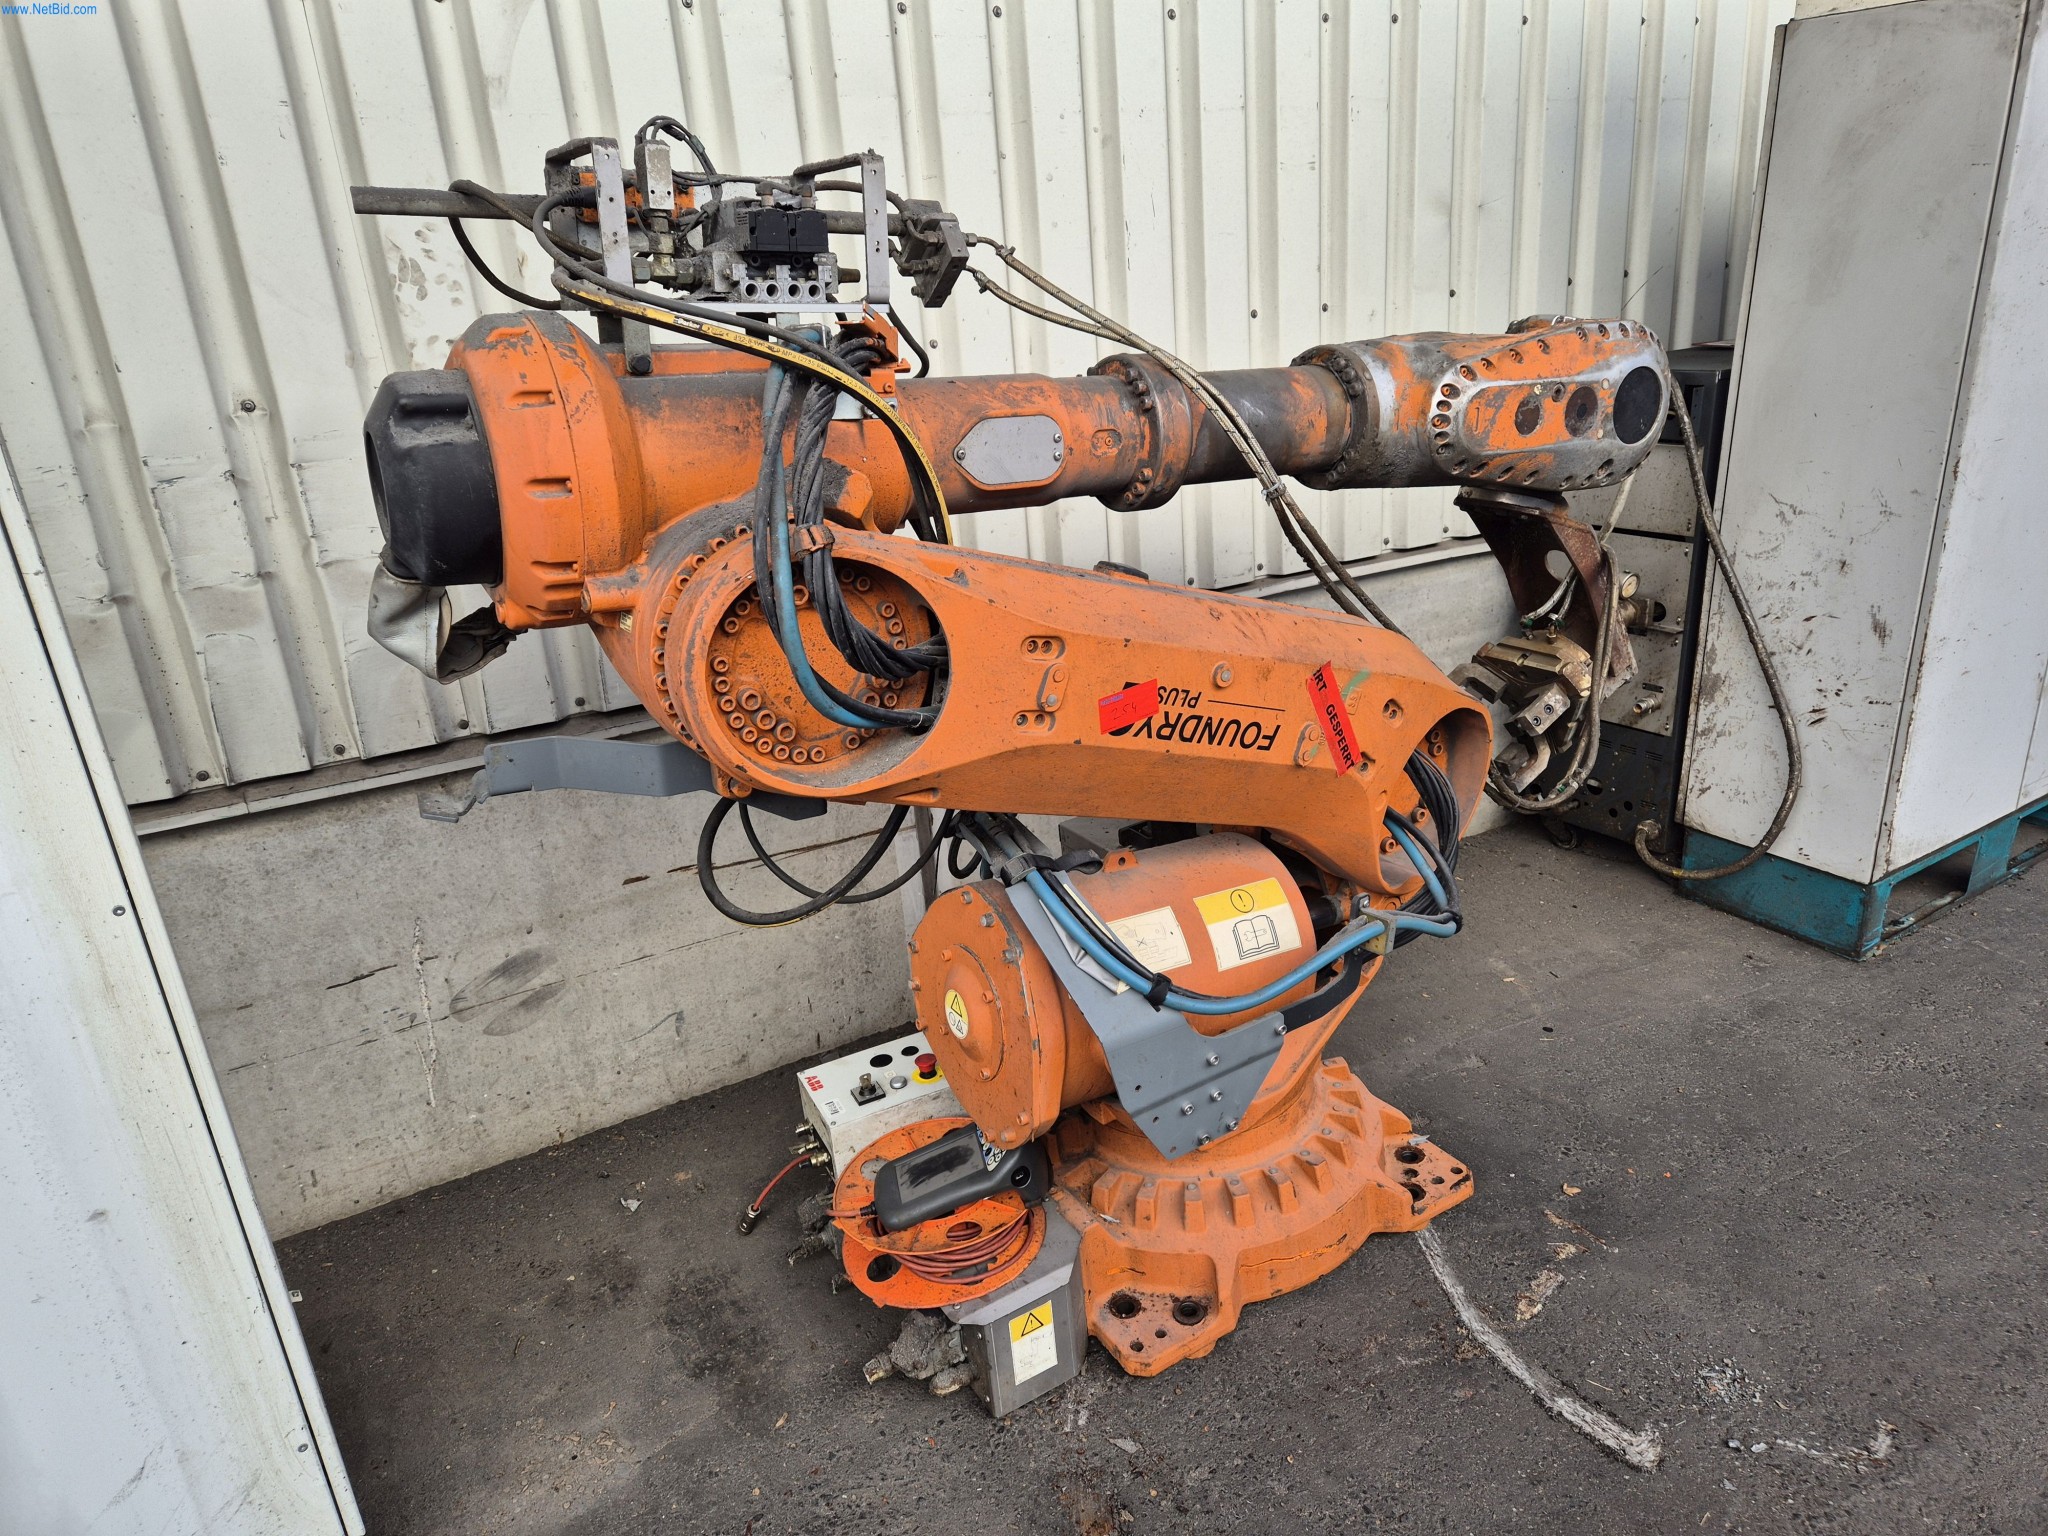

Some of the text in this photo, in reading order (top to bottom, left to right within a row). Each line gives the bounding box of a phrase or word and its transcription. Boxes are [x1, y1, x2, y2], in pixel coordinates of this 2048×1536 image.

[677, 317, 700, 328] Parker
[1158, 685, 1203, 709] PLUS
[1132, 711, 1282, 751] FOUNDRY
[1326, 703, 1355, 770] GESPERRT
[804, 1076, 825, 1092] ABB
